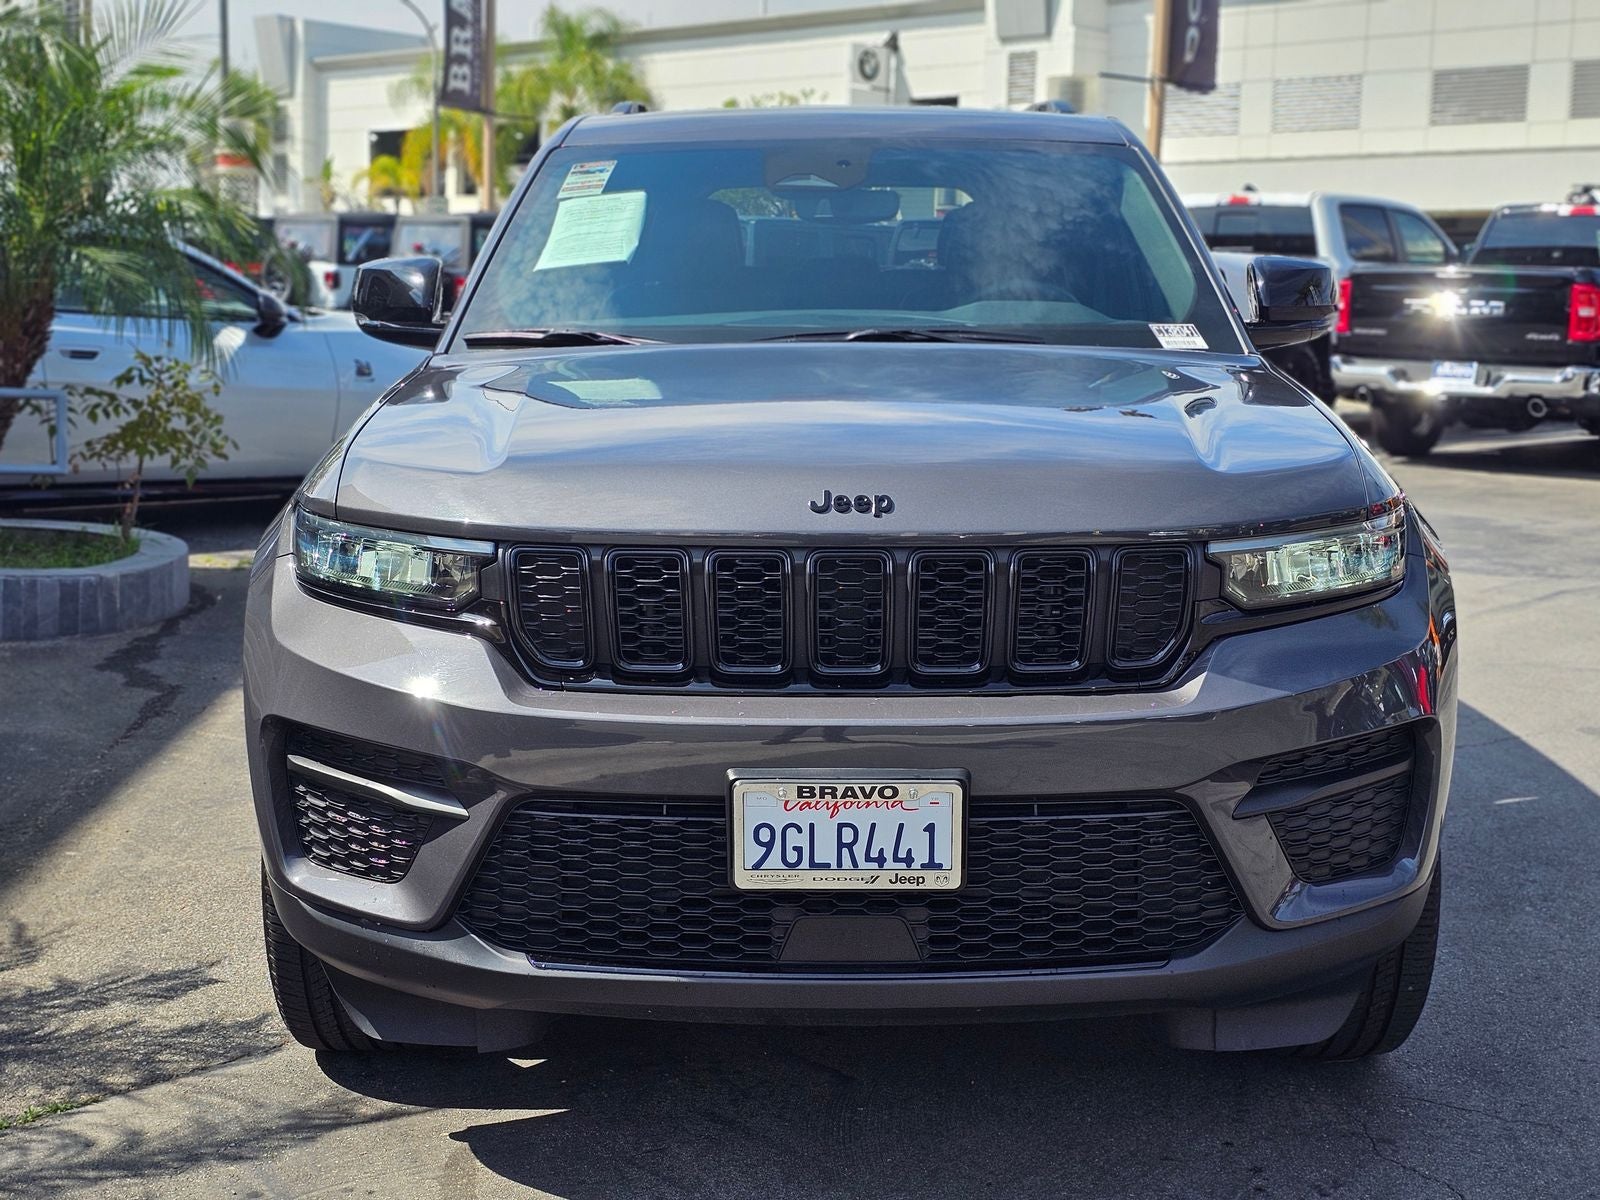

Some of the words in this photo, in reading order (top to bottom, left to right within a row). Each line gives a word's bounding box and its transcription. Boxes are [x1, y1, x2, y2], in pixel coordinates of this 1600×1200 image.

[808, 489, 896, 518] Jeep
[797, 785, 900, 799] BRAVO
[752, 822, 944, 869] 9GLR441
[888, 872, 926, 887] Jeep
